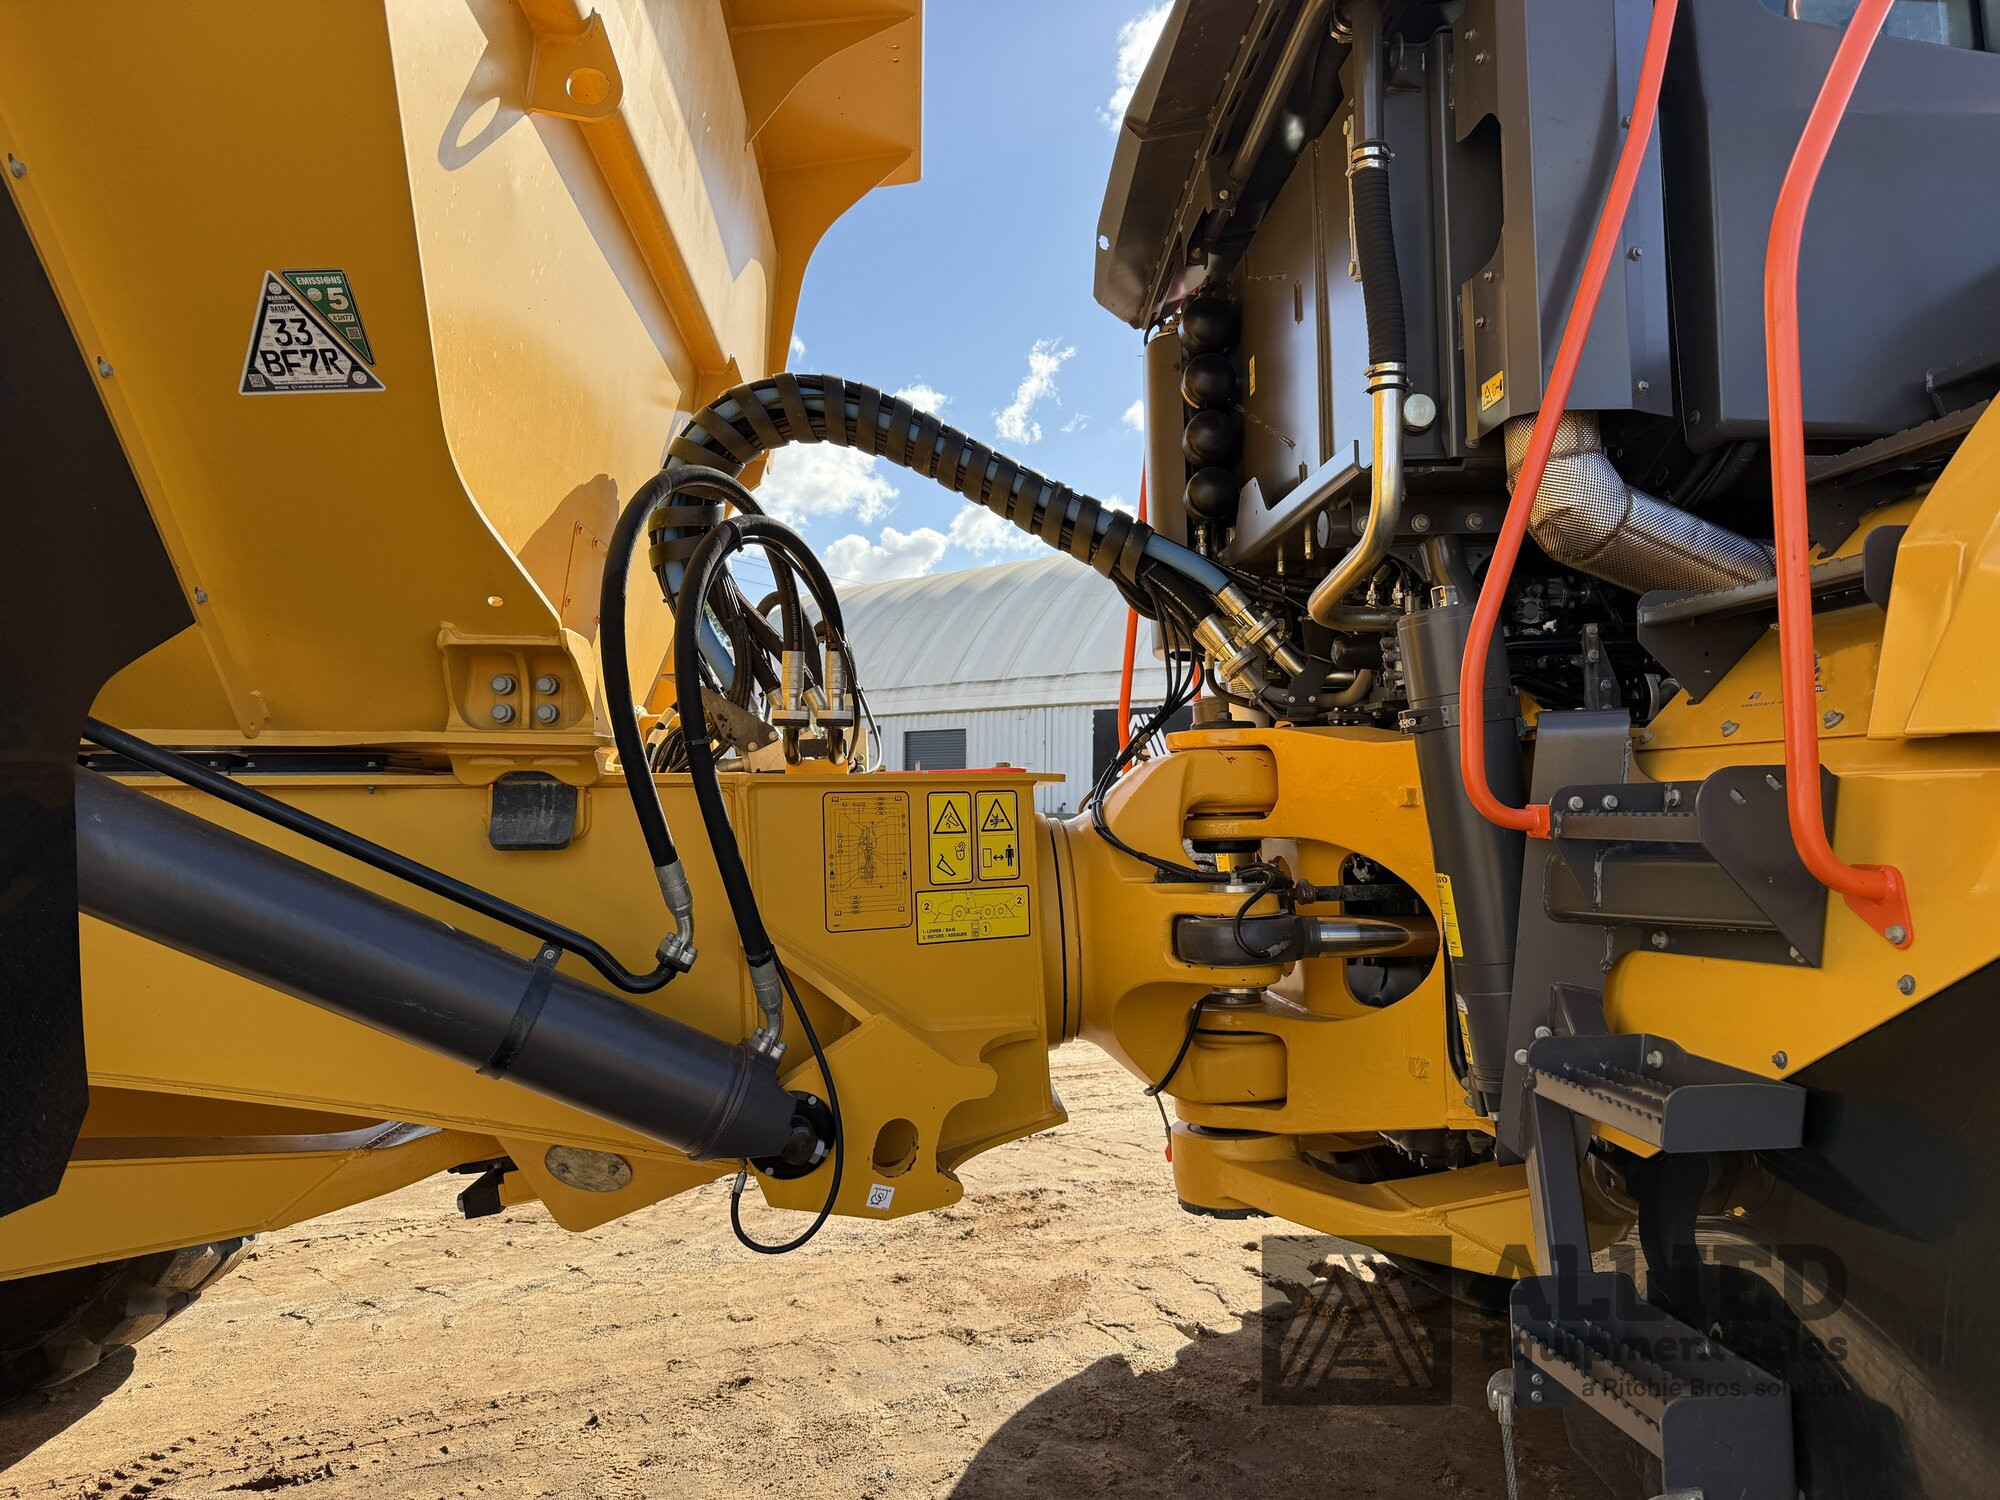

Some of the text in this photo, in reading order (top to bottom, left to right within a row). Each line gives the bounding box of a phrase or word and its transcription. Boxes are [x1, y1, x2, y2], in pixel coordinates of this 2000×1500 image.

[296, 276, 342, 285] EMISSIONS
[327, 287, 349, 310] 5
[268, 318, 314, 346] 33
[260, 348, 345, 378] BF7R
[1017, 896, 1023, 905] 2
[924, 902, 930, 911] 2
[983, 925, 988, 933] 1
